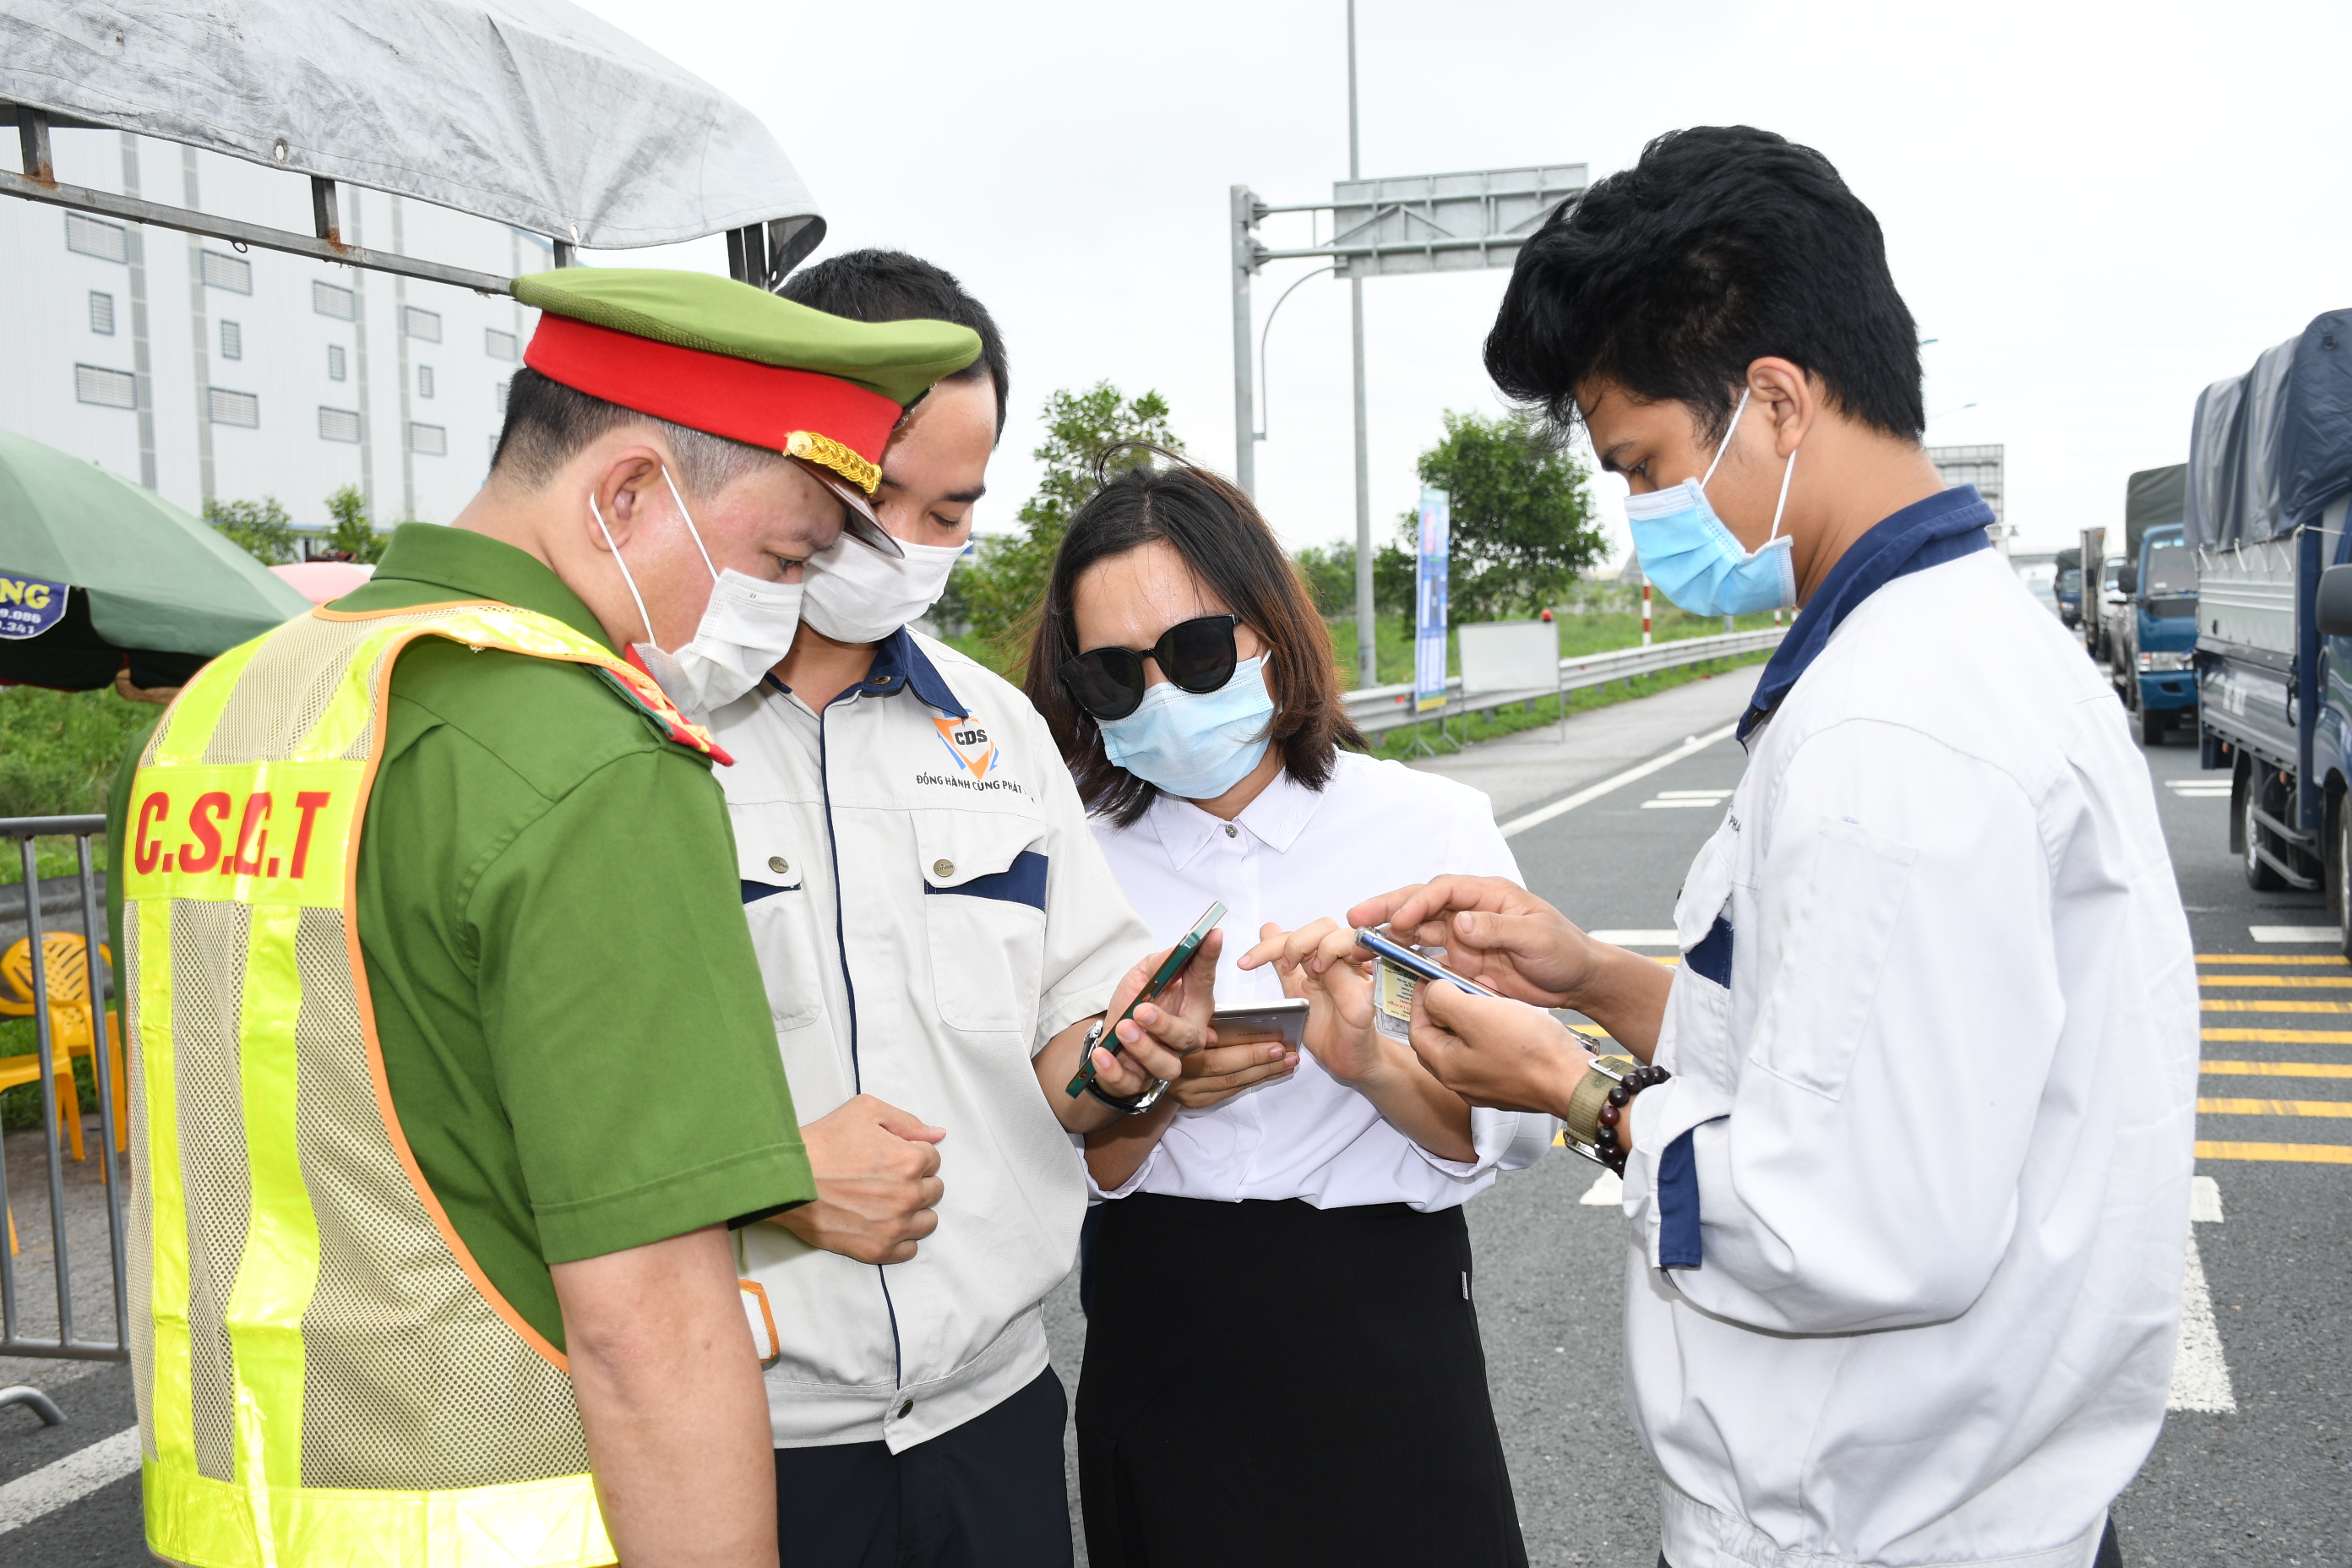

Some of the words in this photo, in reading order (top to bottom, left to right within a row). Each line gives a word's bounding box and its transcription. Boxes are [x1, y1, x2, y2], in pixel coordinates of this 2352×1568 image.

[955, 729, 988, 746] CDS
[945, 776, 971, 789] HÀNH
[972, 780, 1000, 792] CÙNG
